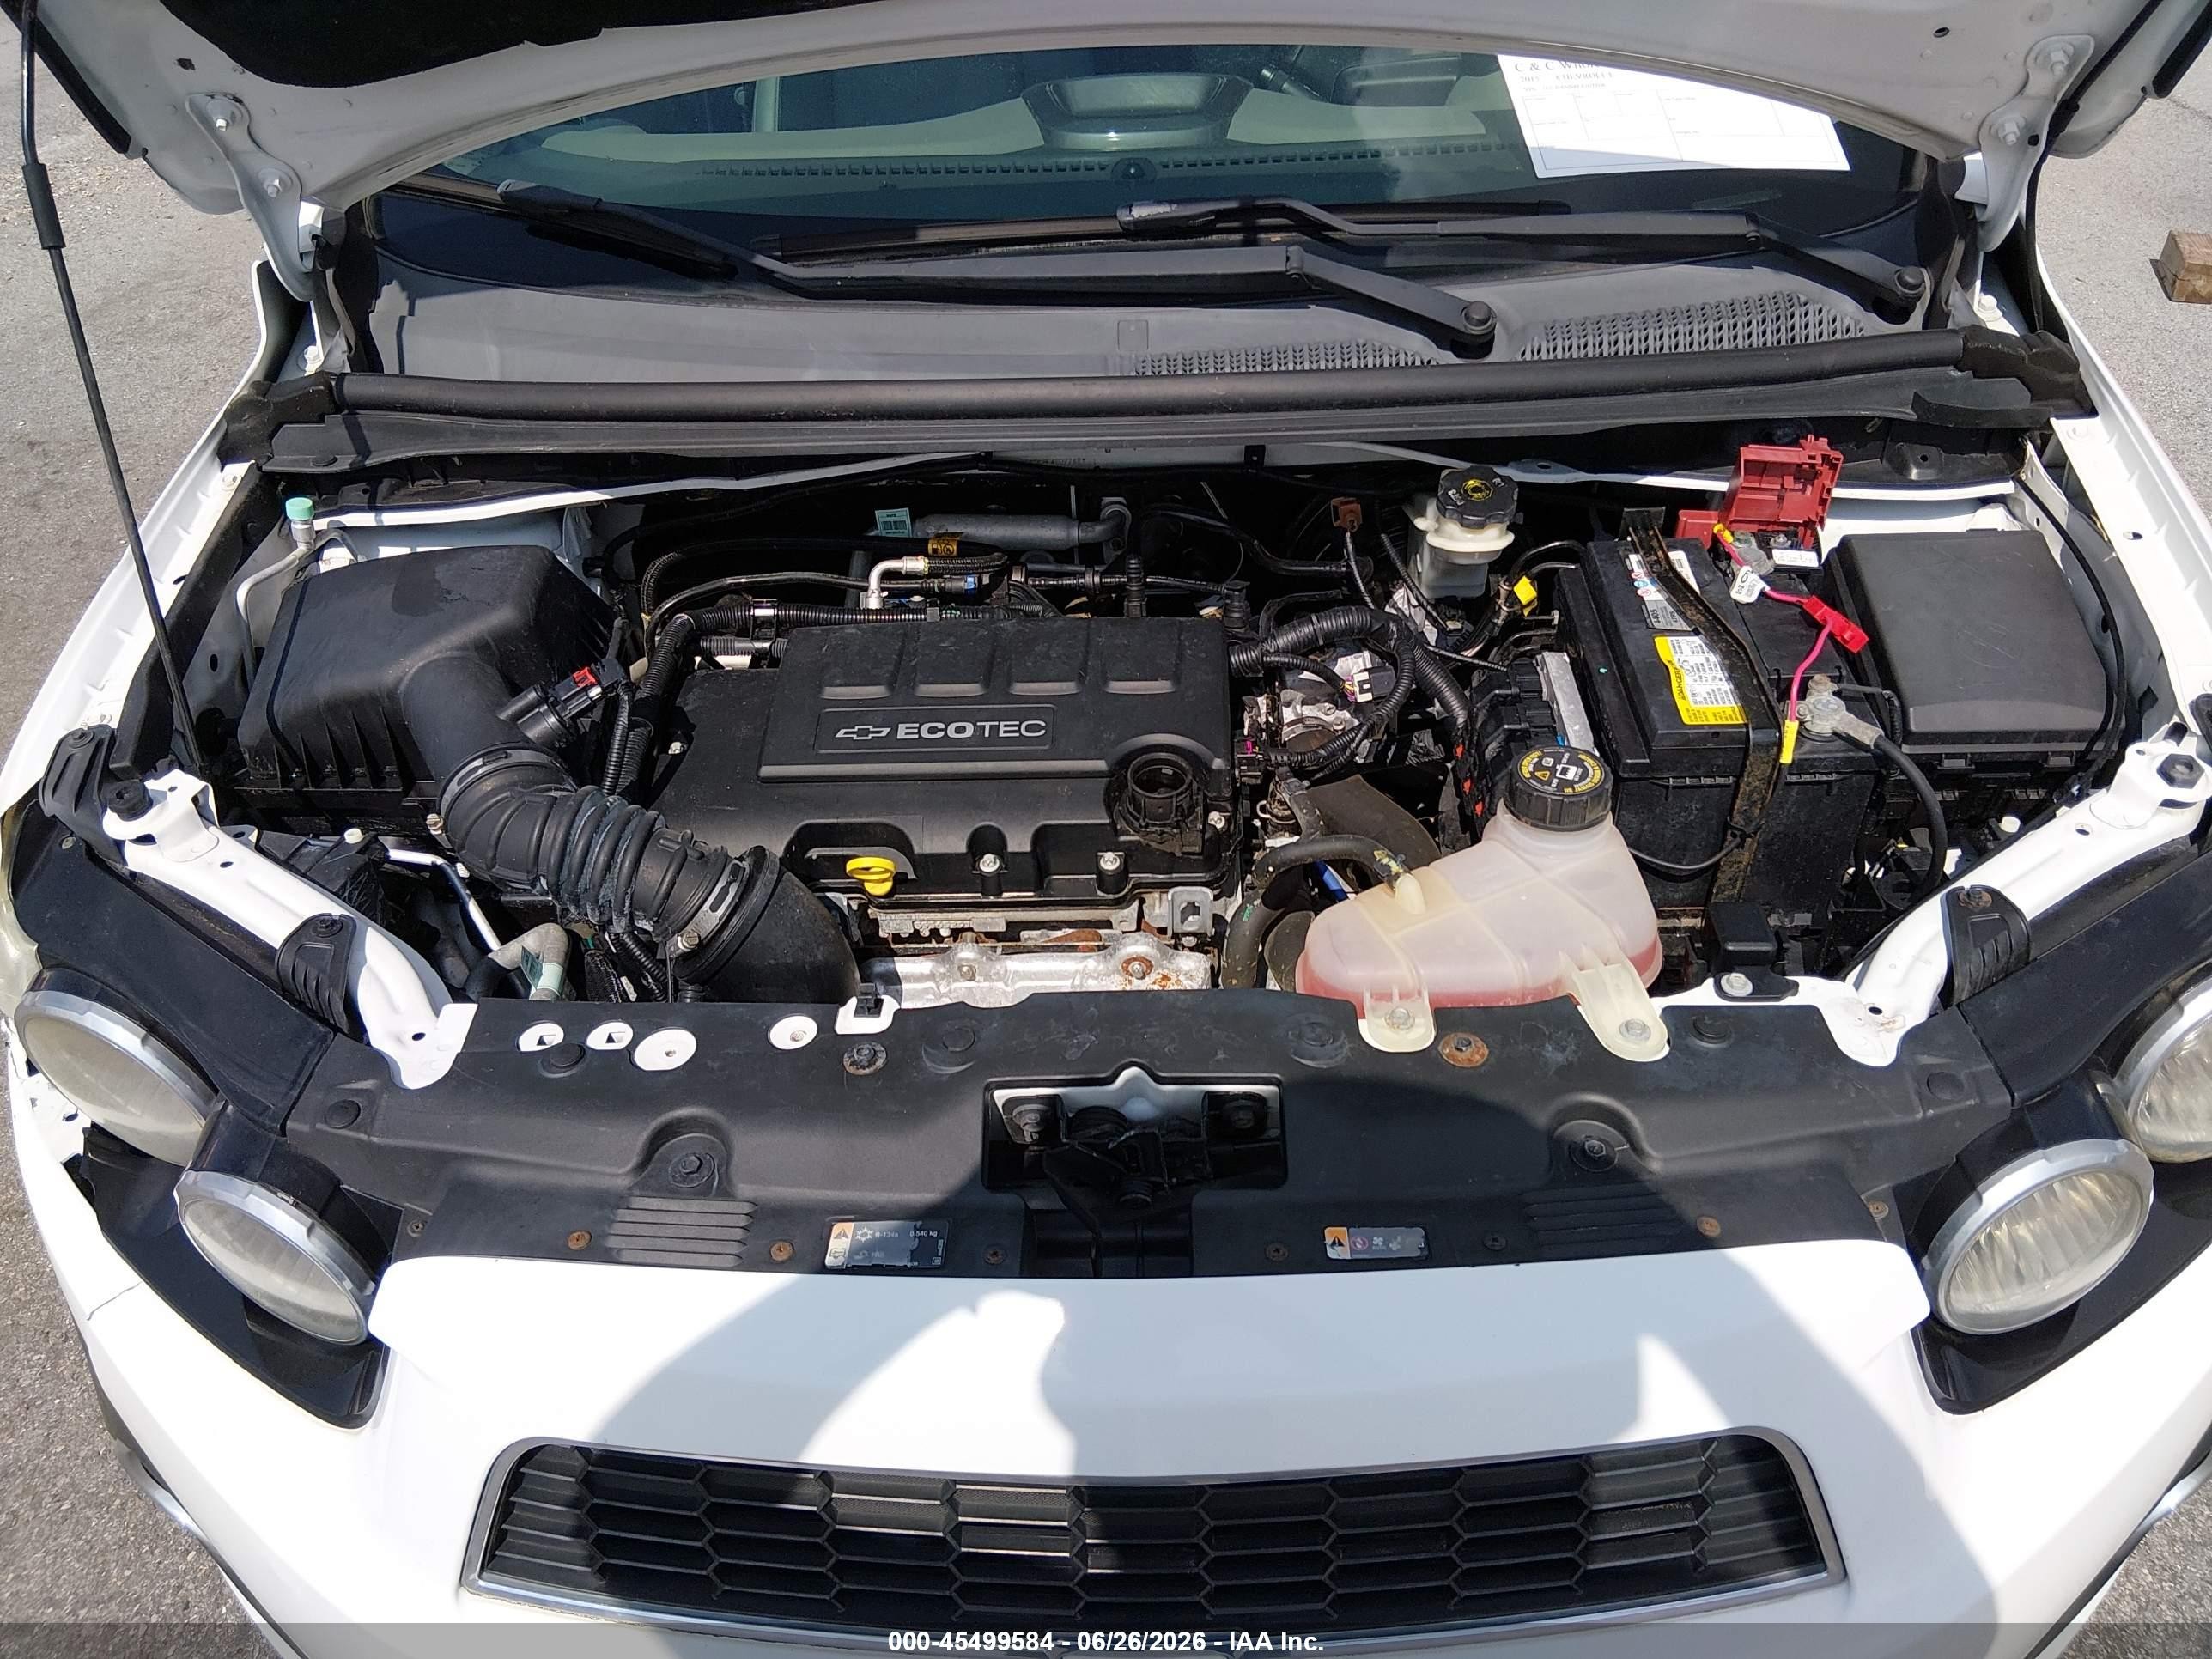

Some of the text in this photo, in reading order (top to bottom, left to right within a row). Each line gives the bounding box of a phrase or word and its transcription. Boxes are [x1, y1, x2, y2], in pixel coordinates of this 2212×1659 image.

[1514, 62, 1525, 72] C
[1529, 61, 1540, 71] &
[1545, 60, 1554, 70] C
[896, 720, 1047, 740] ECOTEC
